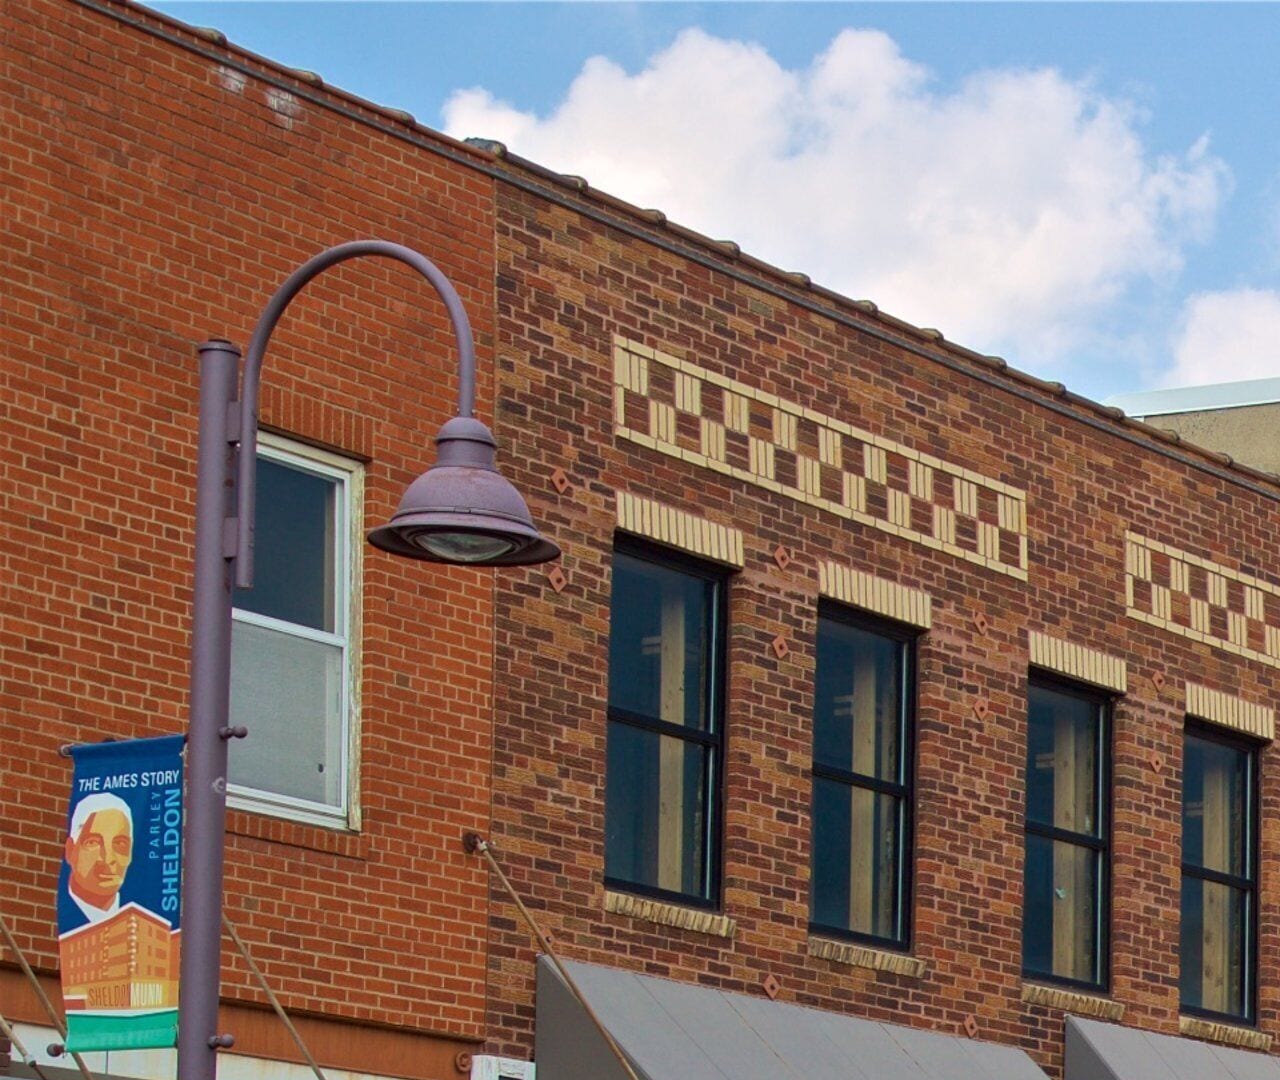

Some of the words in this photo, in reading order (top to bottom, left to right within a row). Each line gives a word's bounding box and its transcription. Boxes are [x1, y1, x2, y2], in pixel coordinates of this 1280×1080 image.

[79, 777, 100, 792] THE
[103, 773, 138, 790] AMES
[141, 770, 180, 787] STORY
[149, 791, 161, 860] PARLEY
[161, 788, 181, 912] SHELDON
